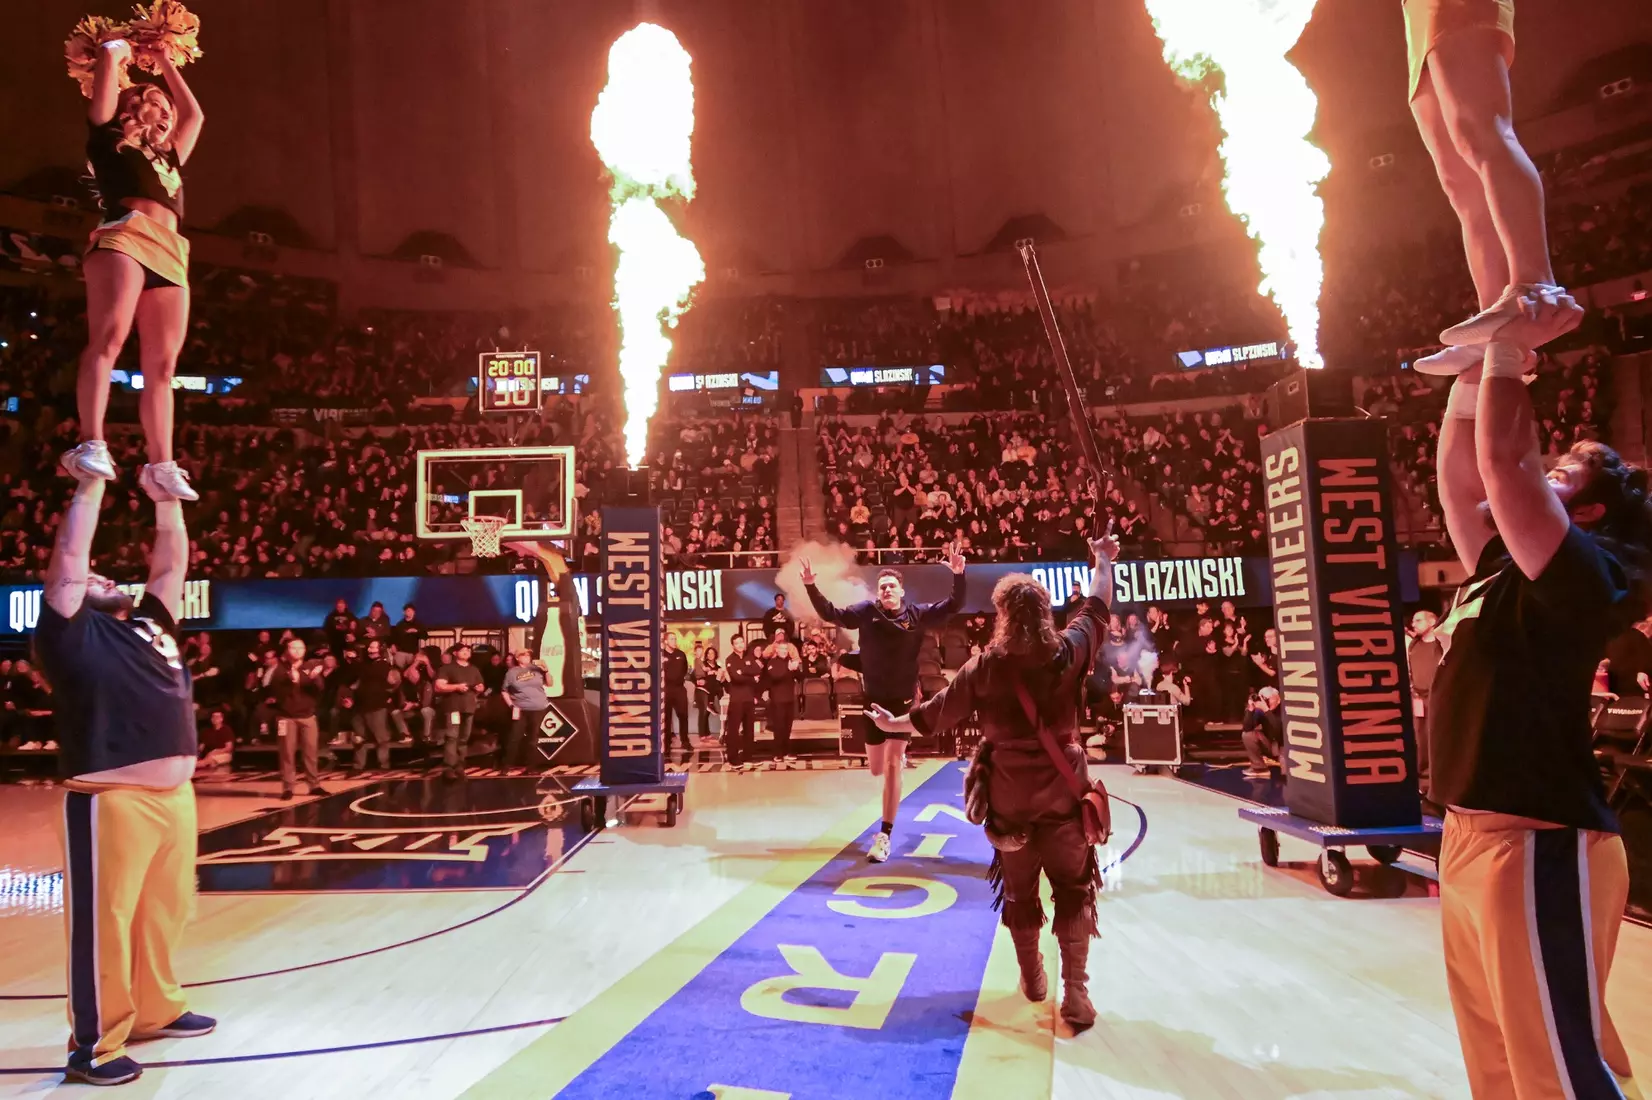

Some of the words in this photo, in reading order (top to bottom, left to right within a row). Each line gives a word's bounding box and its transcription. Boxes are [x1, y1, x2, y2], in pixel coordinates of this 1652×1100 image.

[488, 360, 536, 377] 20:00
[1318, 458, 1386, 569] WEST
[607, 532, 650, 610] WEST
[1114, 557, 1245, 602] SLAZINSKI
[1265, 445, 1326, 783] MOUNTAINEERS
[607, 619, 652, 758] VIRGINIA
[1329, 584, 1407, 785] VIRGINIA
